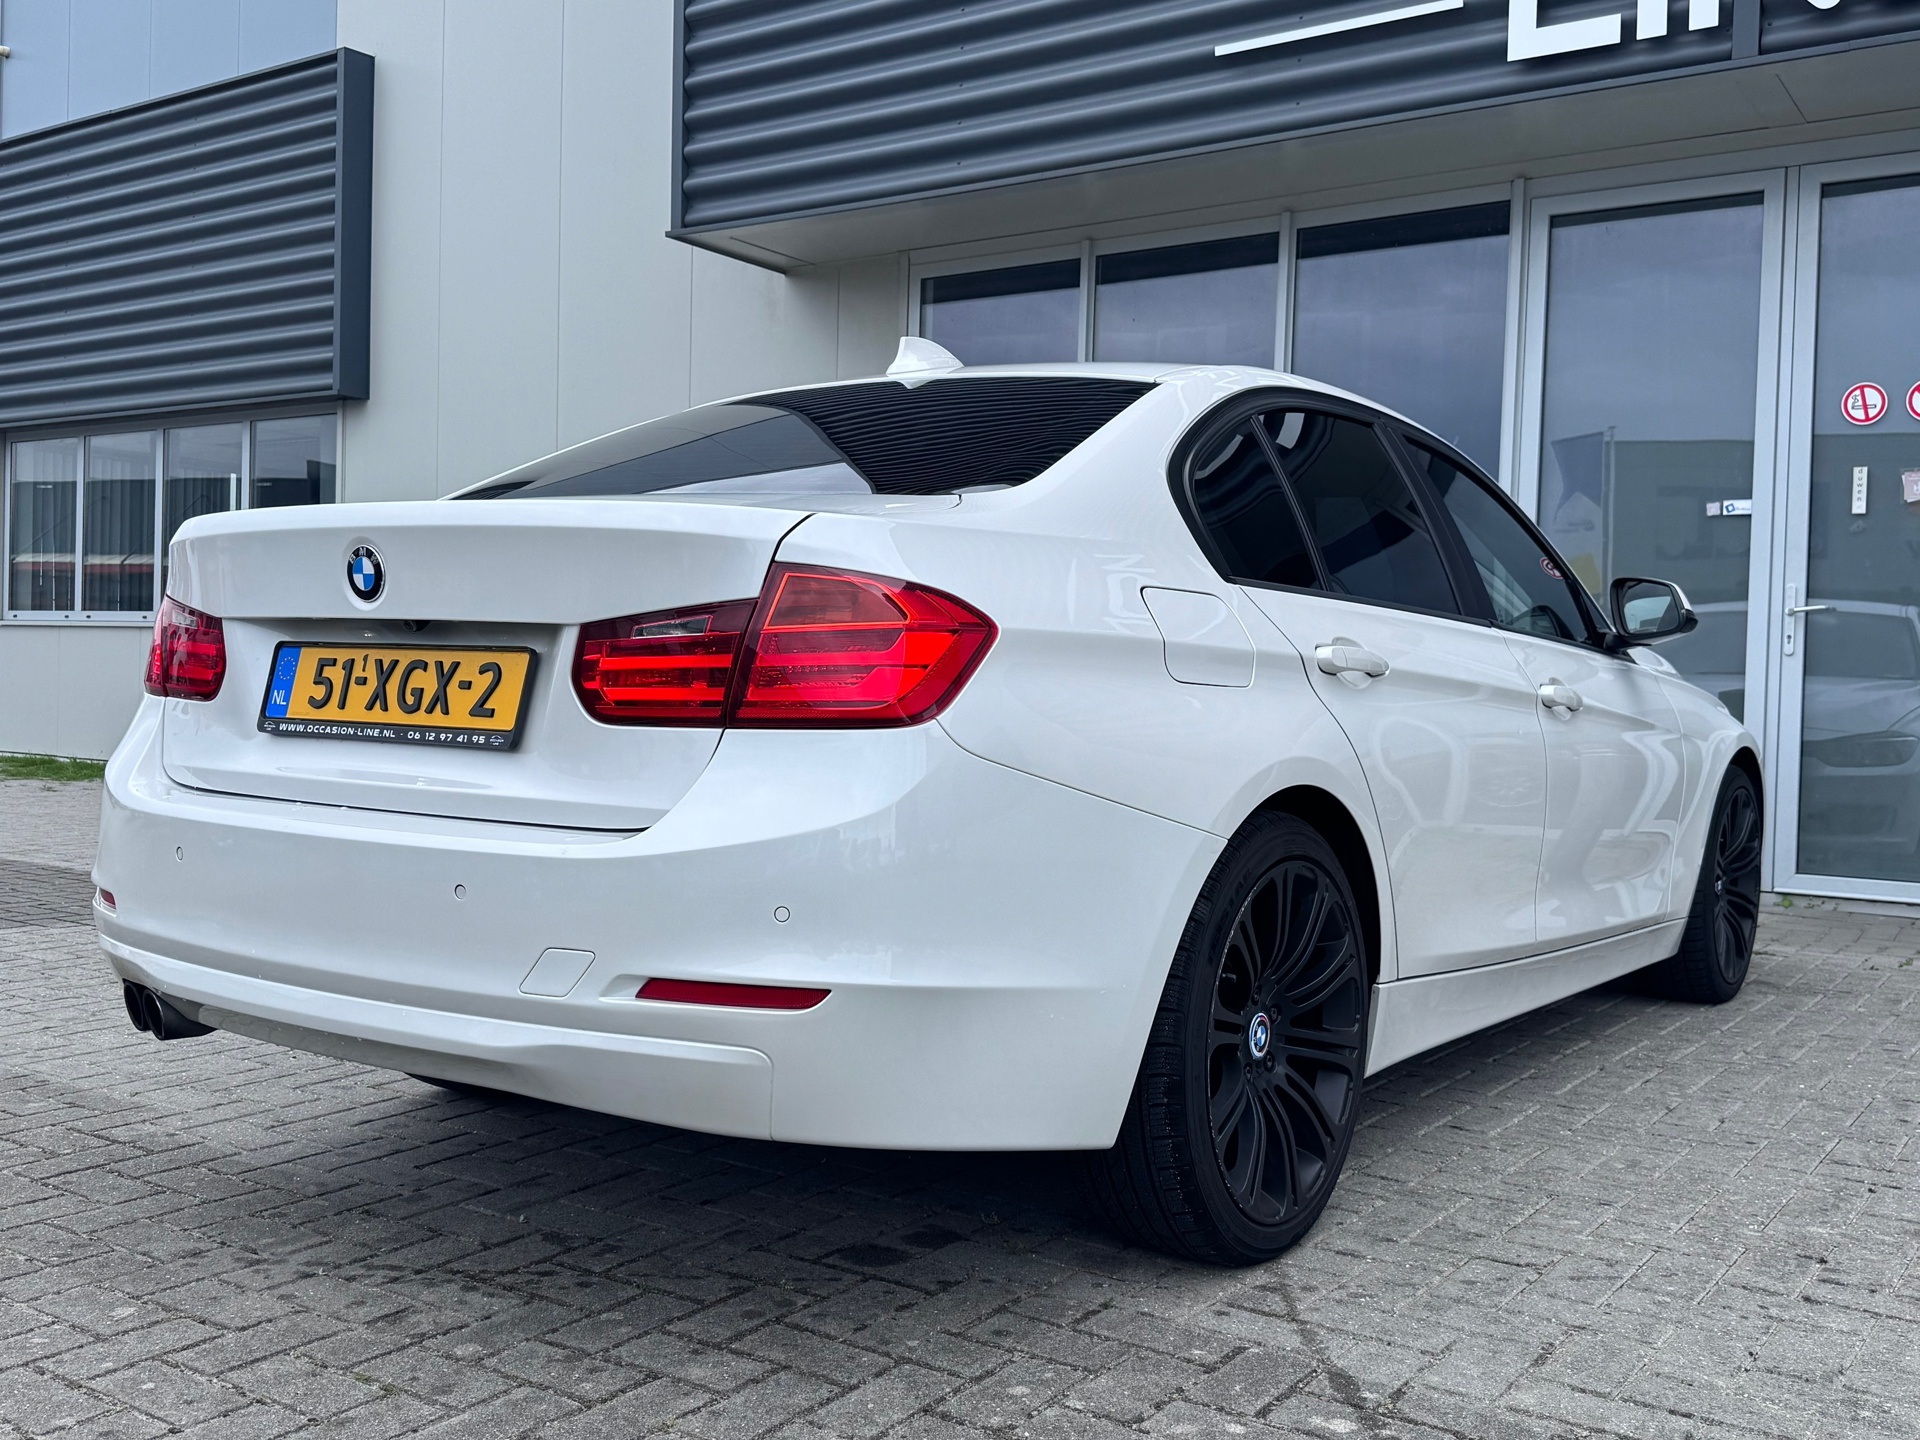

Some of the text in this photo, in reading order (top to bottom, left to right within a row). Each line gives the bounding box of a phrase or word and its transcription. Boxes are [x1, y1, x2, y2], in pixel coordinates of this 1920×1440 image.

[271, 689, 287, 705] NL
[307, 657, 503, 718] 51-XGX-2
[279, 722, 396, 738] WWW.OCCASION-LINE.NL
[407, 731, 421, 739] 06
[425, 732, 436, 741] 12
[439, 733, 453, 742] 97
[456, 734, 468, 743] 41
[472, 735, 486, 744] 95
